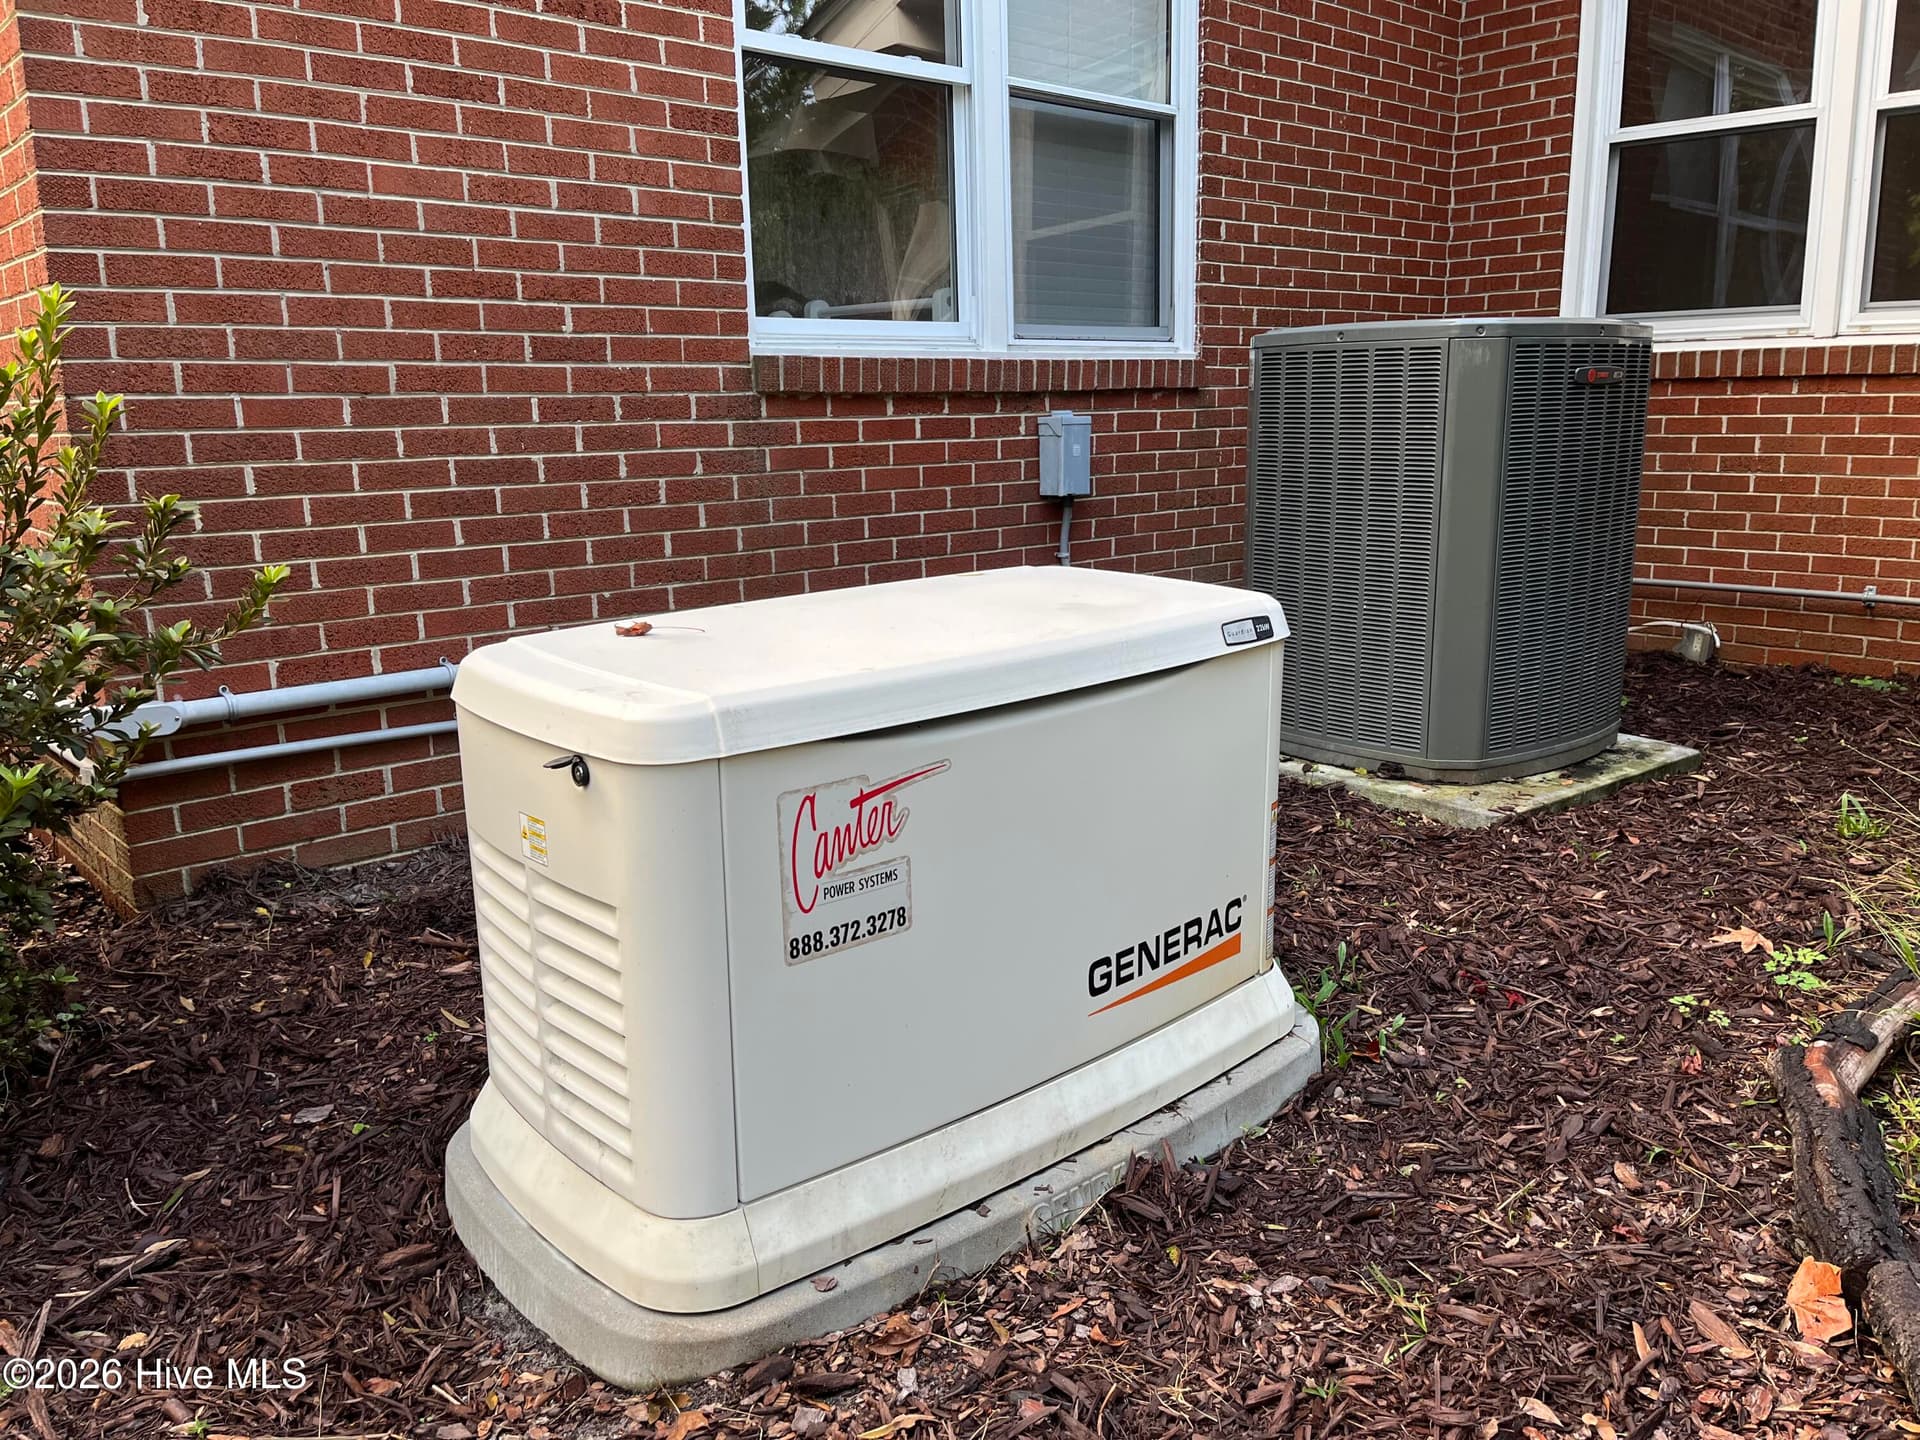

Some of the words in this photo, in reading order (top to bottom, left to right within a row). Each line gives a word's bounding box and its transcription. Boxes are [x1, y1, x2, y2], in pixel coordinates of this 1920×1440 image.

[791, 764, 947, 914] Canter
[823, 881, 855, 901] POWER
[858, 868, 898, 891] SYSTEMS
[789, 906, 907, 960] 888.372.3278
[1088, 897, 1243, 998] GENERAC
